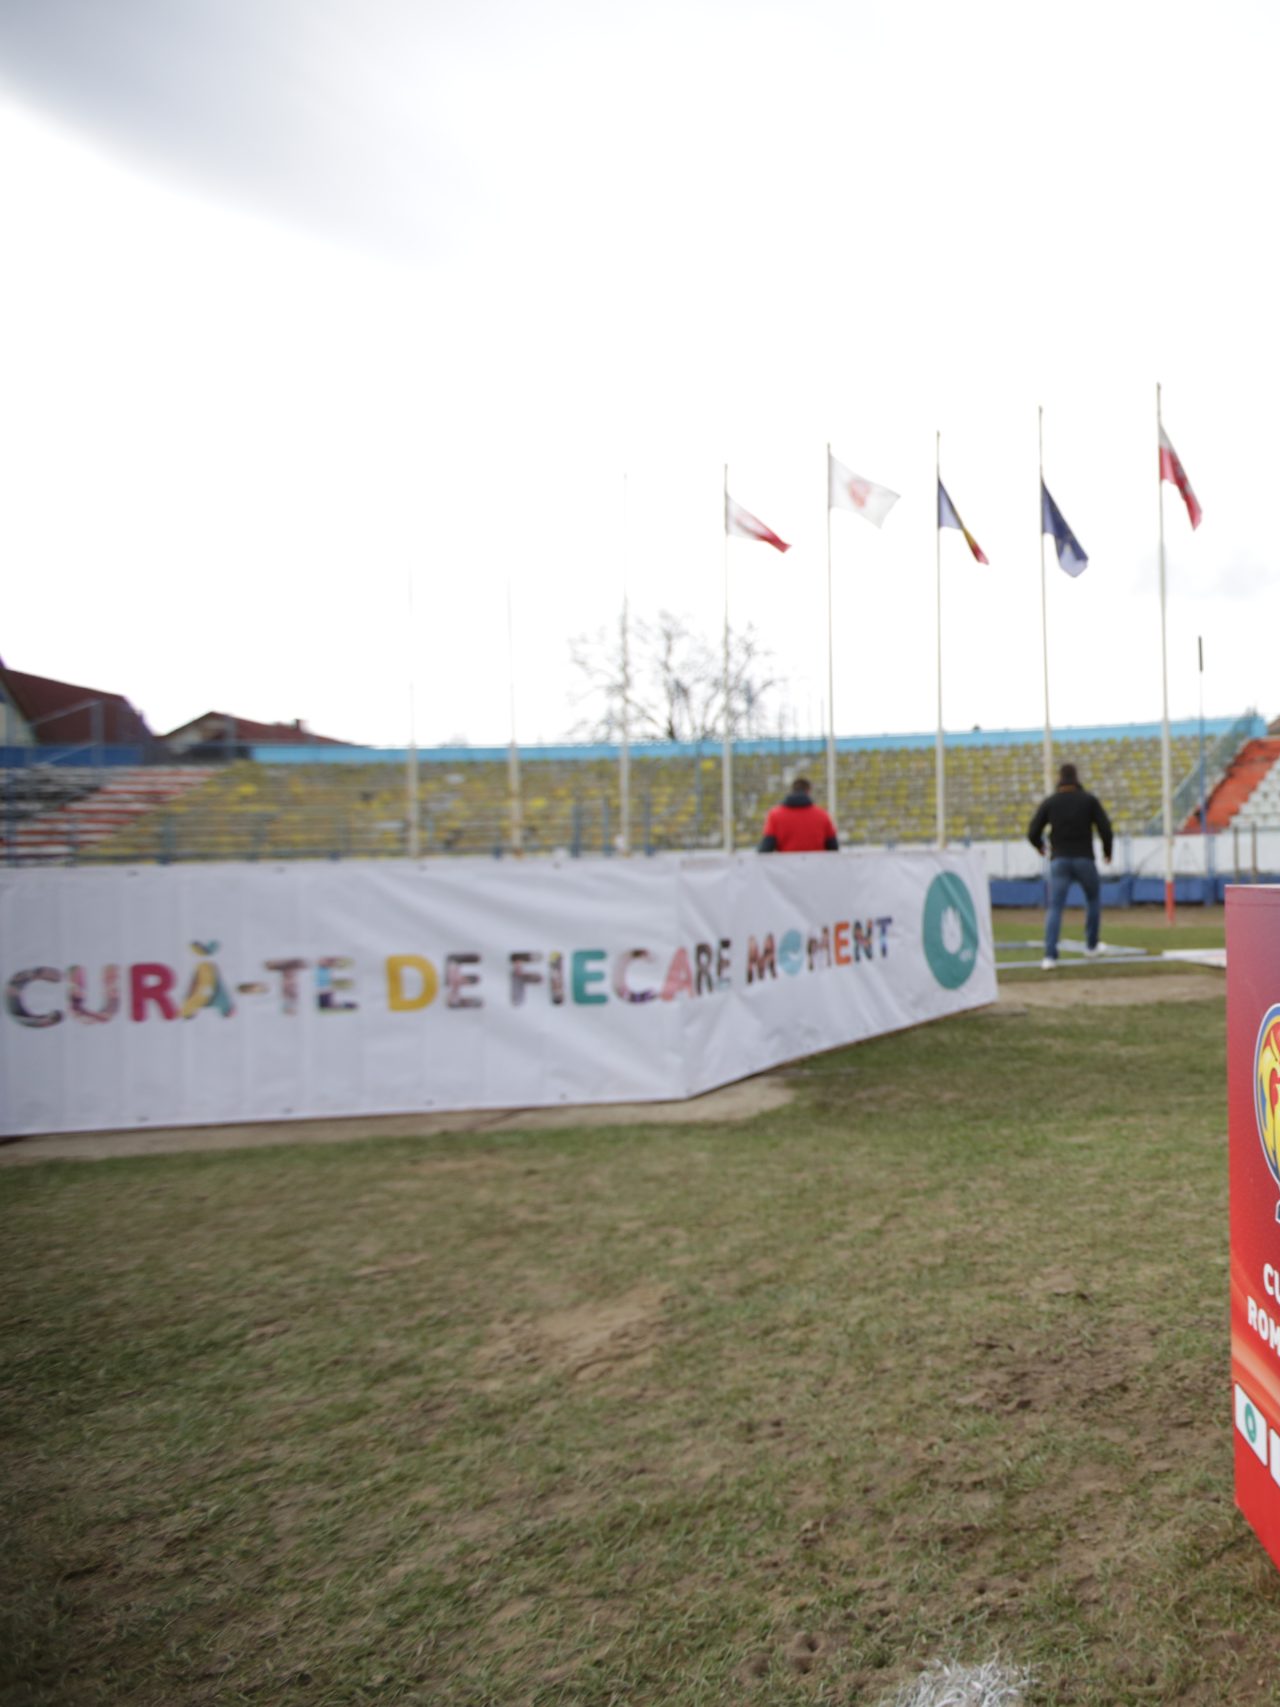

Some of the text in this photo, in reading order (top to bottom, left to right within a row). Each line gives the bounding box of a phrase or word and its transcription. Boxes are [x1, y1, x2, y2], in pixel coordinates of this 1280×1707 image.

[6, 917, 893, 1028] CURĂ-TE DE FIECARE MOMENT
